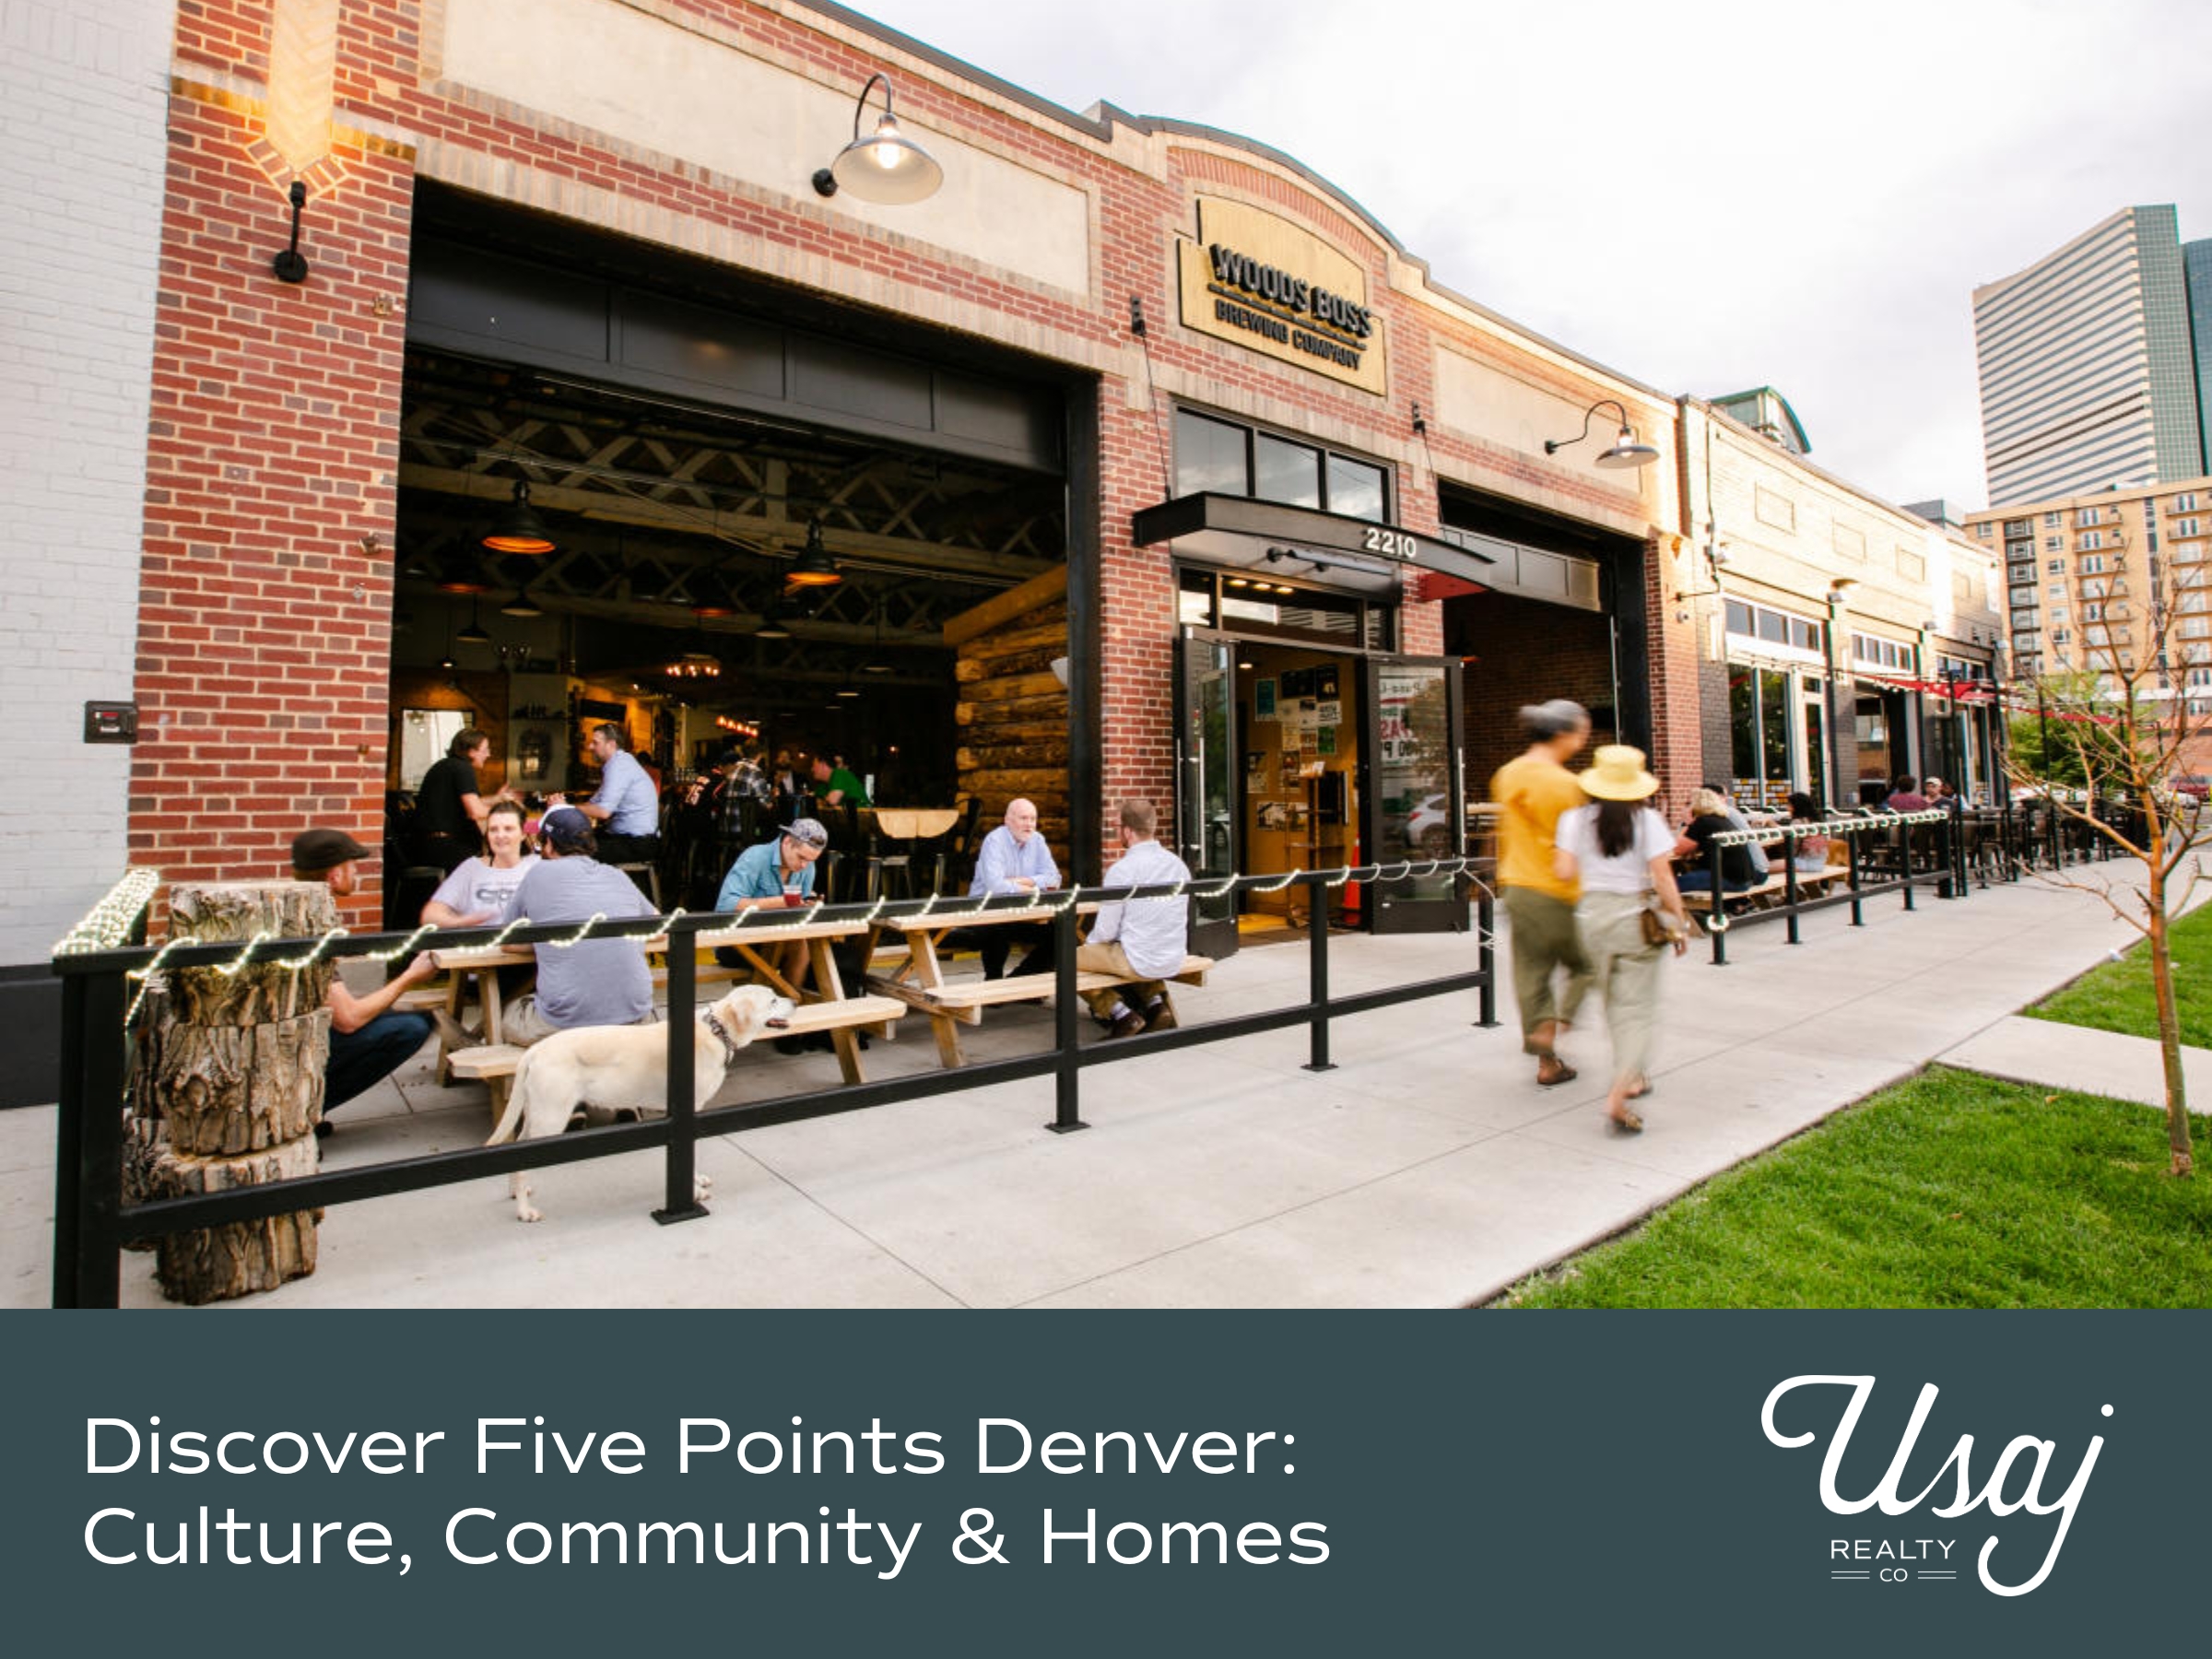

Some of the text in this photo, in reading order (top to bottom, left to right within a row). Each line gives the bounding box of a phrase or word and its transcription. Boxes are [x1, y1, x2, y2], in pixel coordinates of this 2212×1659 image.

[1209, 243, 1372, 337] WOODS BOSS
[1215, 299, 1360, 371] BREWING COMPANY
[1367, 527, 1417, 559] 2210
